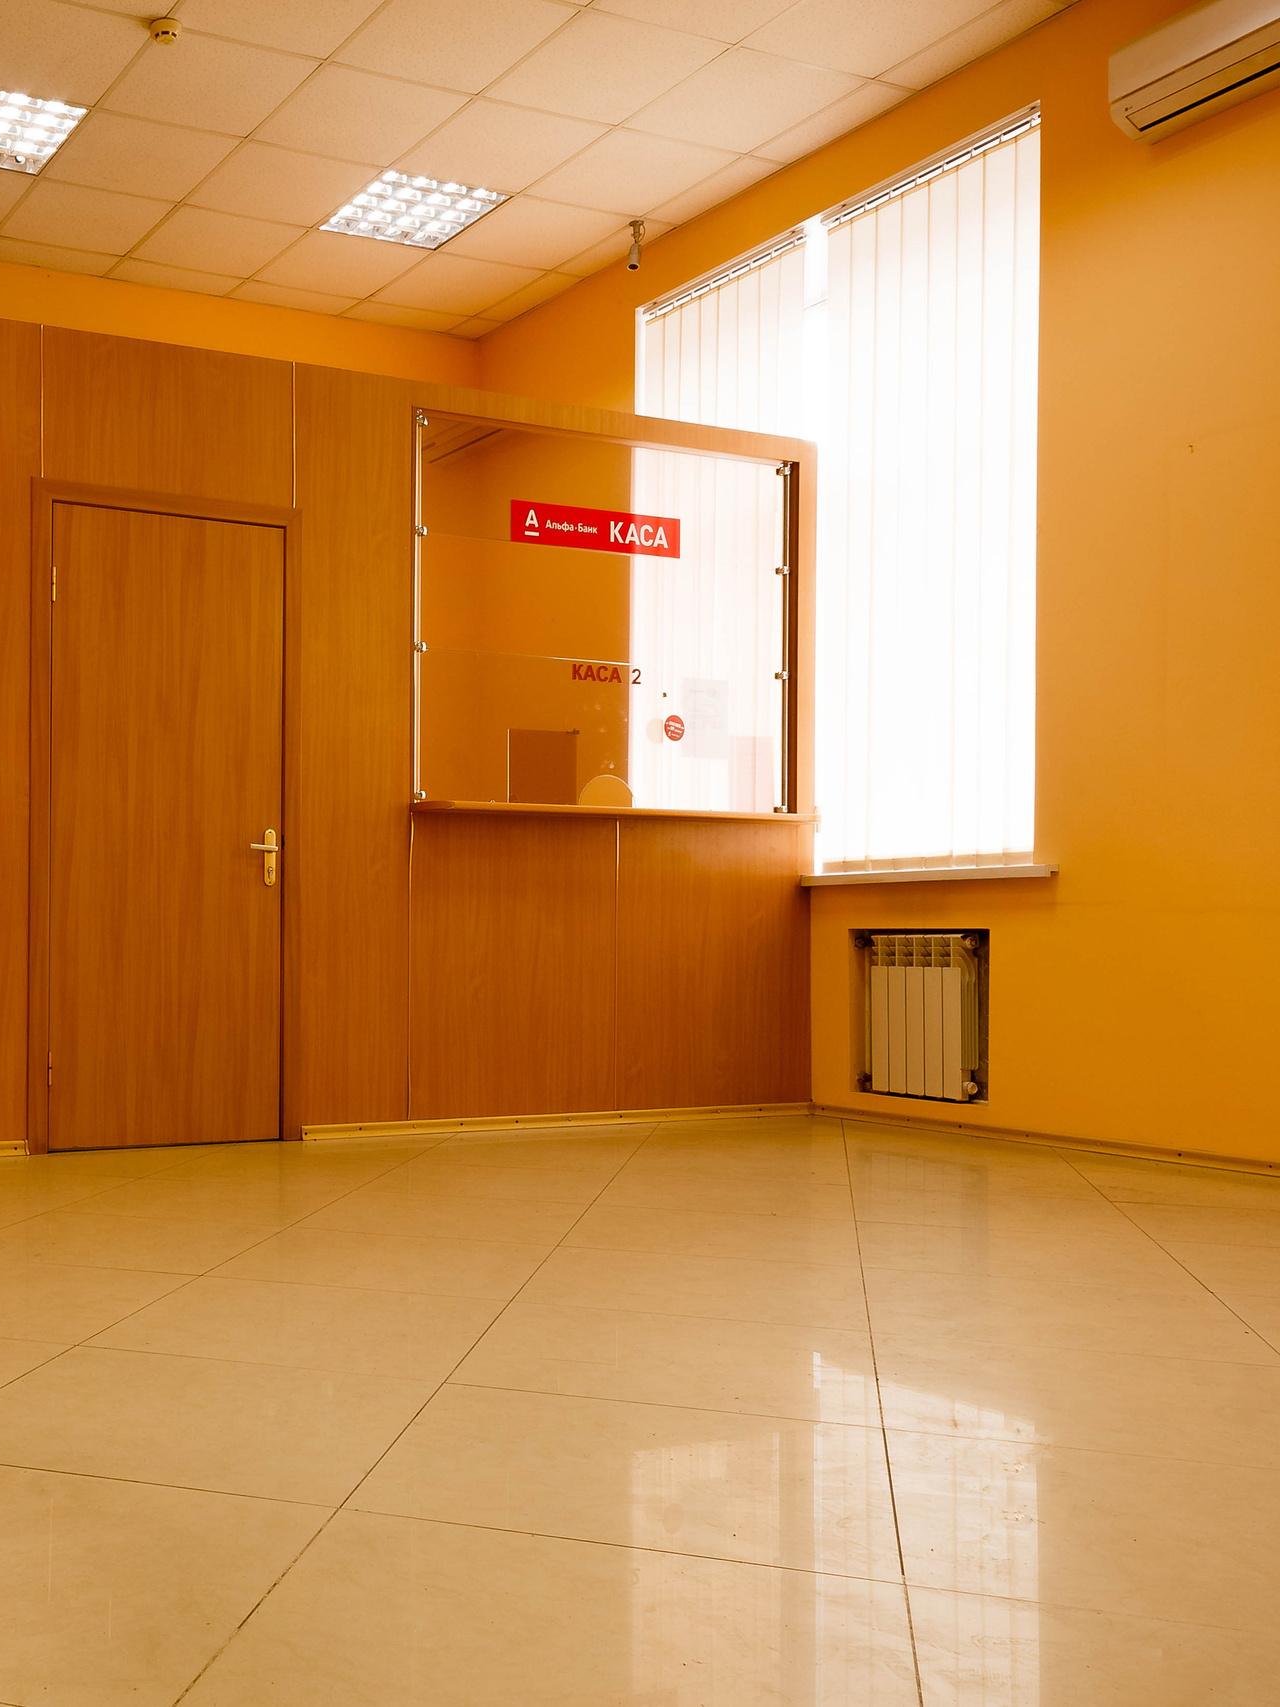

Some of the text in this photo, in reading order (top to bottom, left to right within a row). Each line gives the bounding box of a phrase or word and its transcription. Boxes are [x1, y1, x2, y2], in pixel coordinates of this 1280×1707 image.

[609, 520, 668, 549] КАСА
[572, 663, 642, 685] КАСА 2
